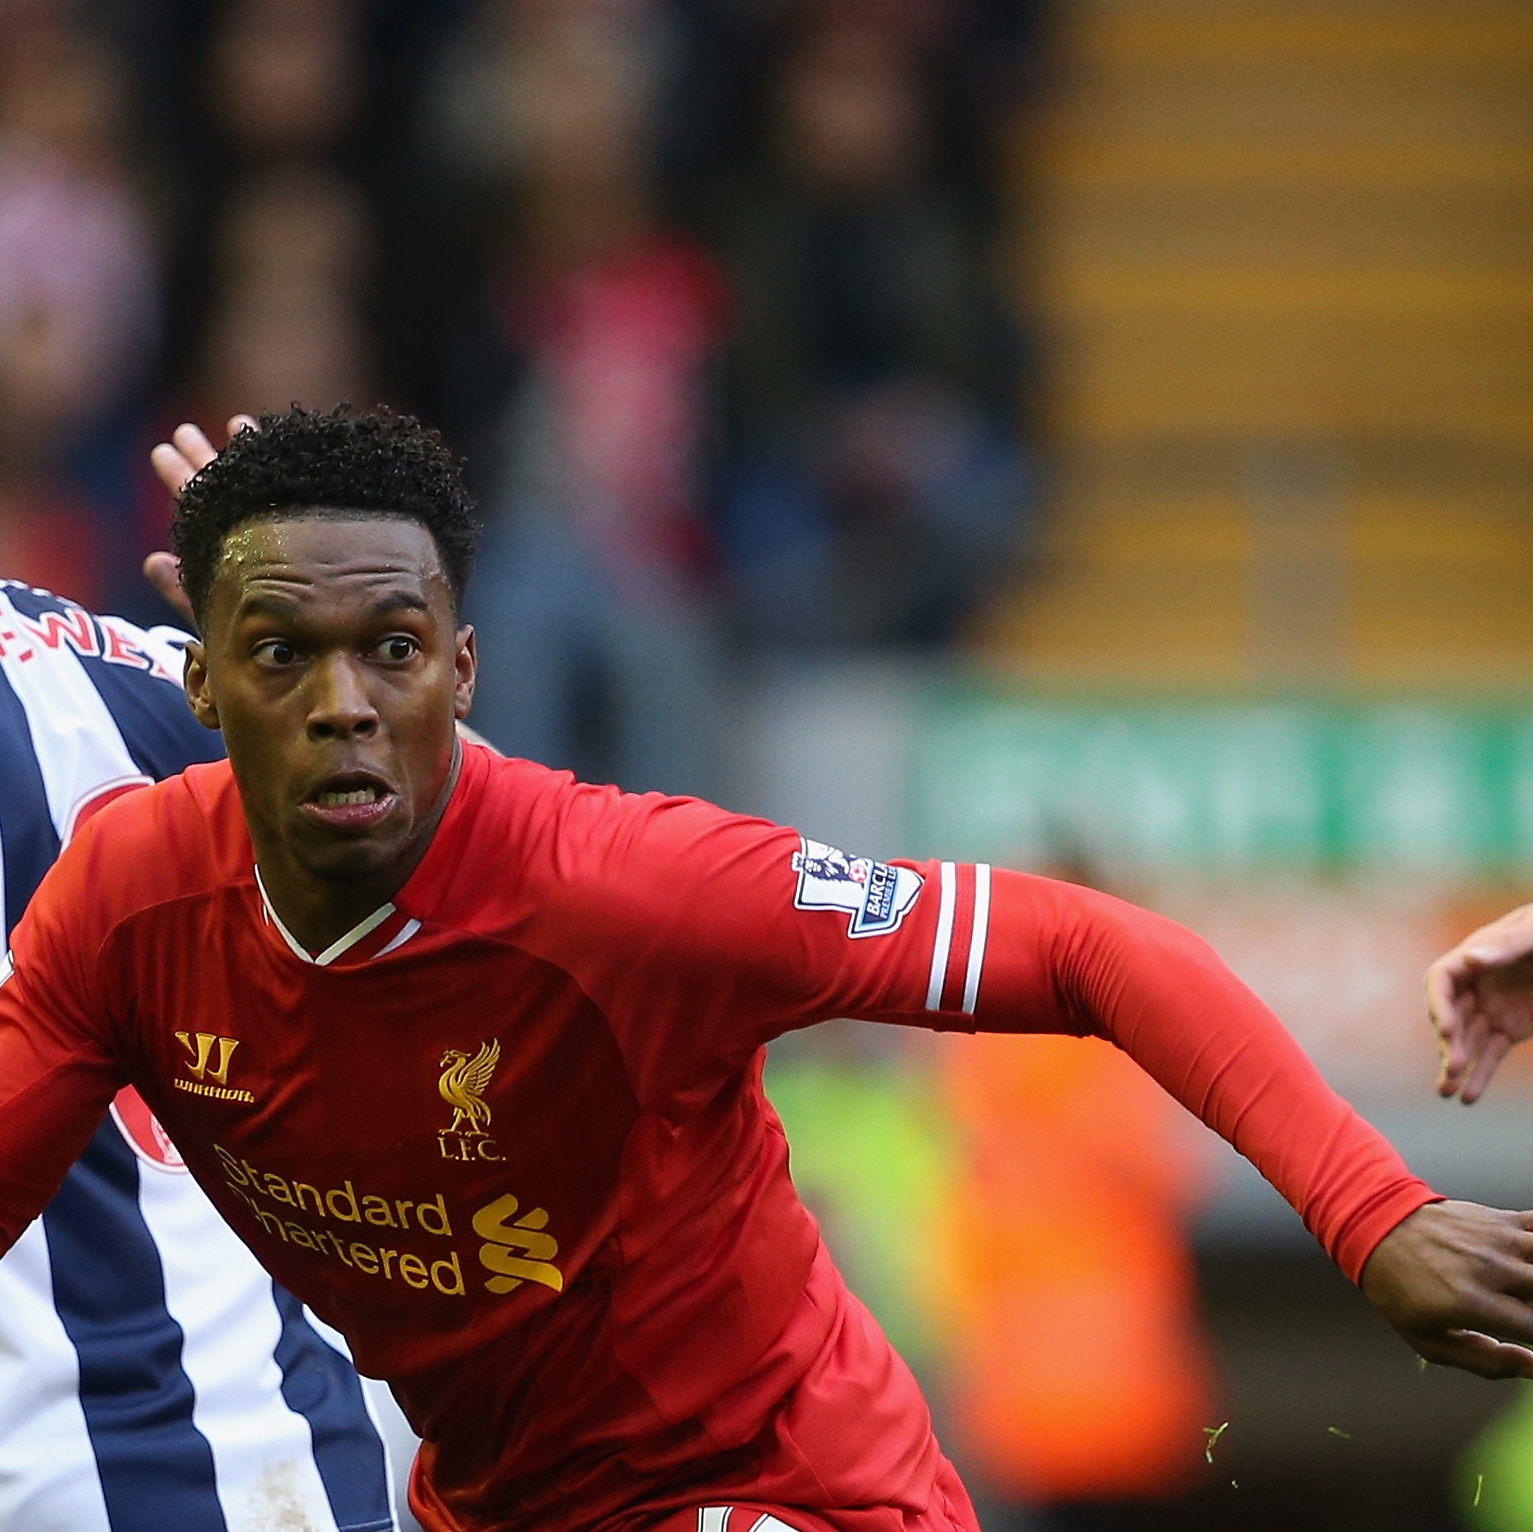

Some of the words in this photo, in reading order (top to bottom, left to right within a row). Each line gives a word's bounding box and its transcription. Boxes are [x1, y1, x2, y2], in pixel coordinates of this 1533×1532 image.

[173, 1078, 251, 1102] WARRIOR
[437, 1136, 507, 1161] L.F.C.
[213, 1143, 453, 1237] Standard
